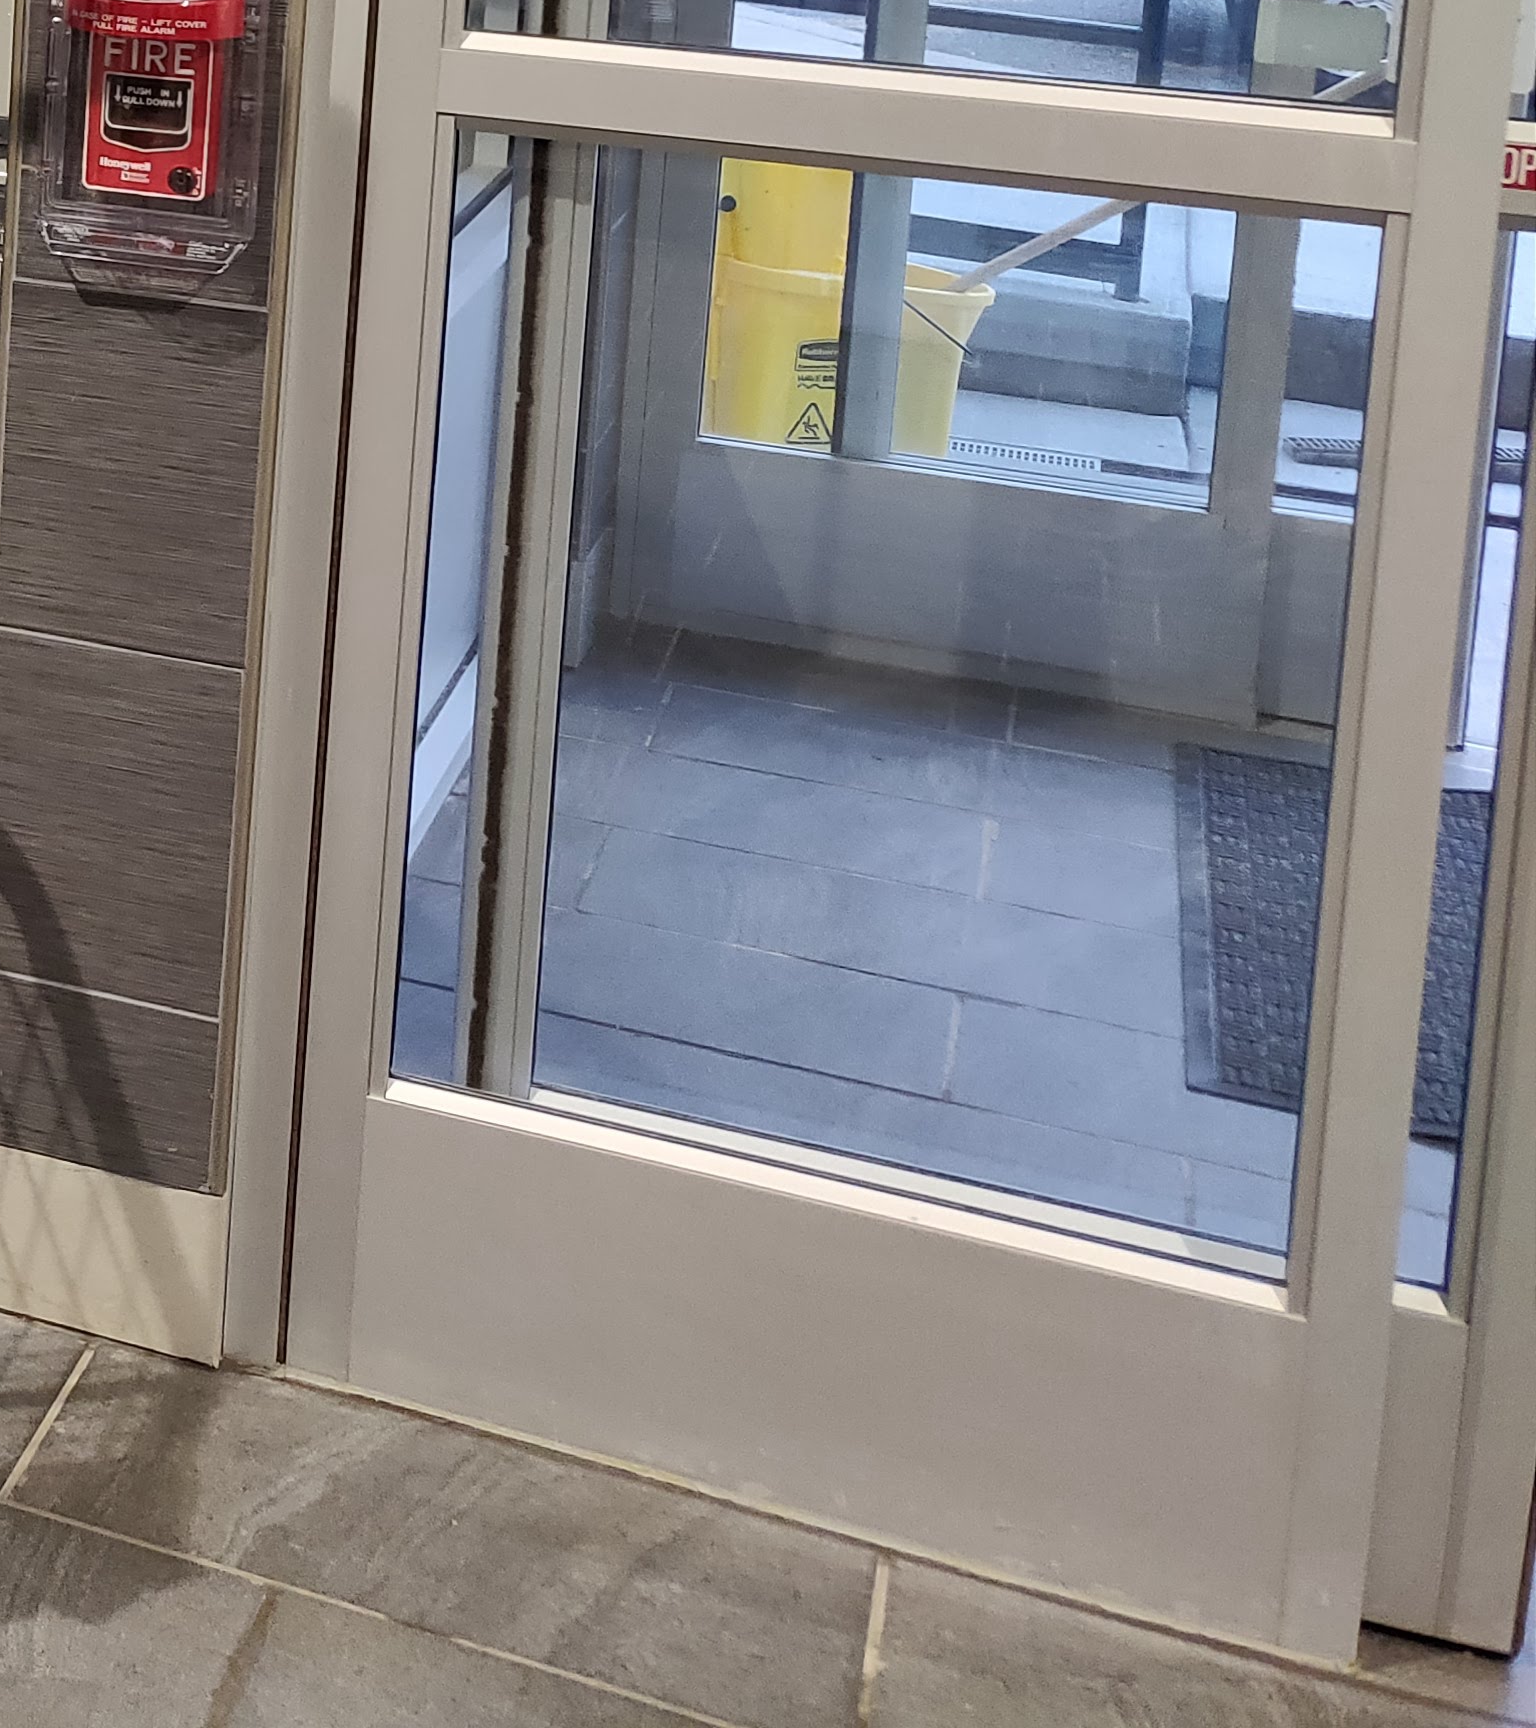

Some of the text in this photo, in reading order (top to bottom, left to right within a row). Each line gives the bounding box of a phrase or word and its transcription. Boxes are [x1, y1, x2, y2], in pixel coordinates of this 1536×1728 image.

[101, 14, 115, 22] OF
[117, 16, 138, 25] FIRE
[151, 18, 171, 27] LIFT
[175, 20, 207, 29] COVER
[116, 23, 137, 33] FIRE
[140, 26, 176, 35] ALARM
[104, 37, 196, 76] FIRE
[127, 86, 170, 97] PUSH IN
[146, 98, 176, 108] DOWN
